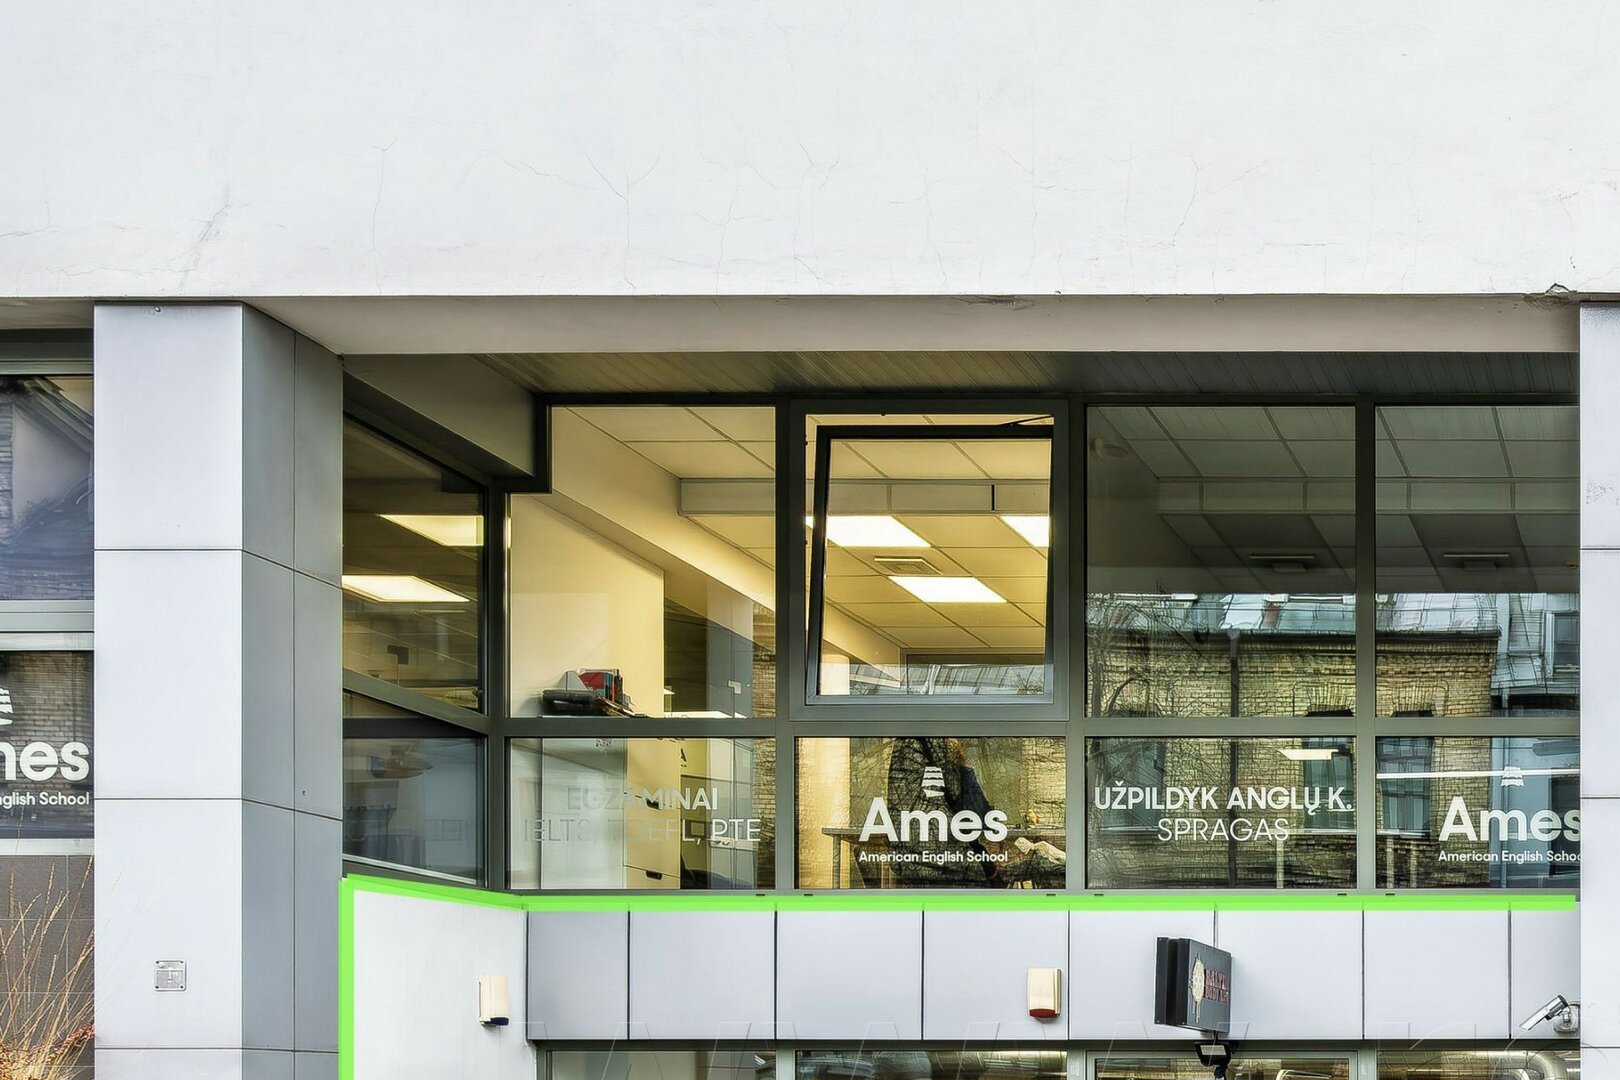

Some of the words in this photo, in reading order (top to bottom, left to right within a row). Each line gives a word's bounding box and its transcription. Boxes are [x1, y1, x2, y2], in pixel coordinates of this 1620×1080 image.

[39, 791, 90, 806] School
[567, 787, 718, 810] EGZAMINAI
[1094, 780, 1218, 811] UŽPILDYK
[1226, 786, 1322, 816] ANGLŲ
[1328, 787, 1353, 811] K.
[711, 819, 761, 842] PTE
[858, 796, 1008, 843] Ames
[1157, 817, 1290, 842] SPRAGAS
[1438, 796, 1581, 843] Ames
[859, 850, 919, 863] American
[922, 850, 964, 865] English
[966, 850, 1008, 863] School
[1438, 850, 1498, 863] American
[1502, 850, 1543, 865] English
[1546, 850, 1581, 863] Schoo
